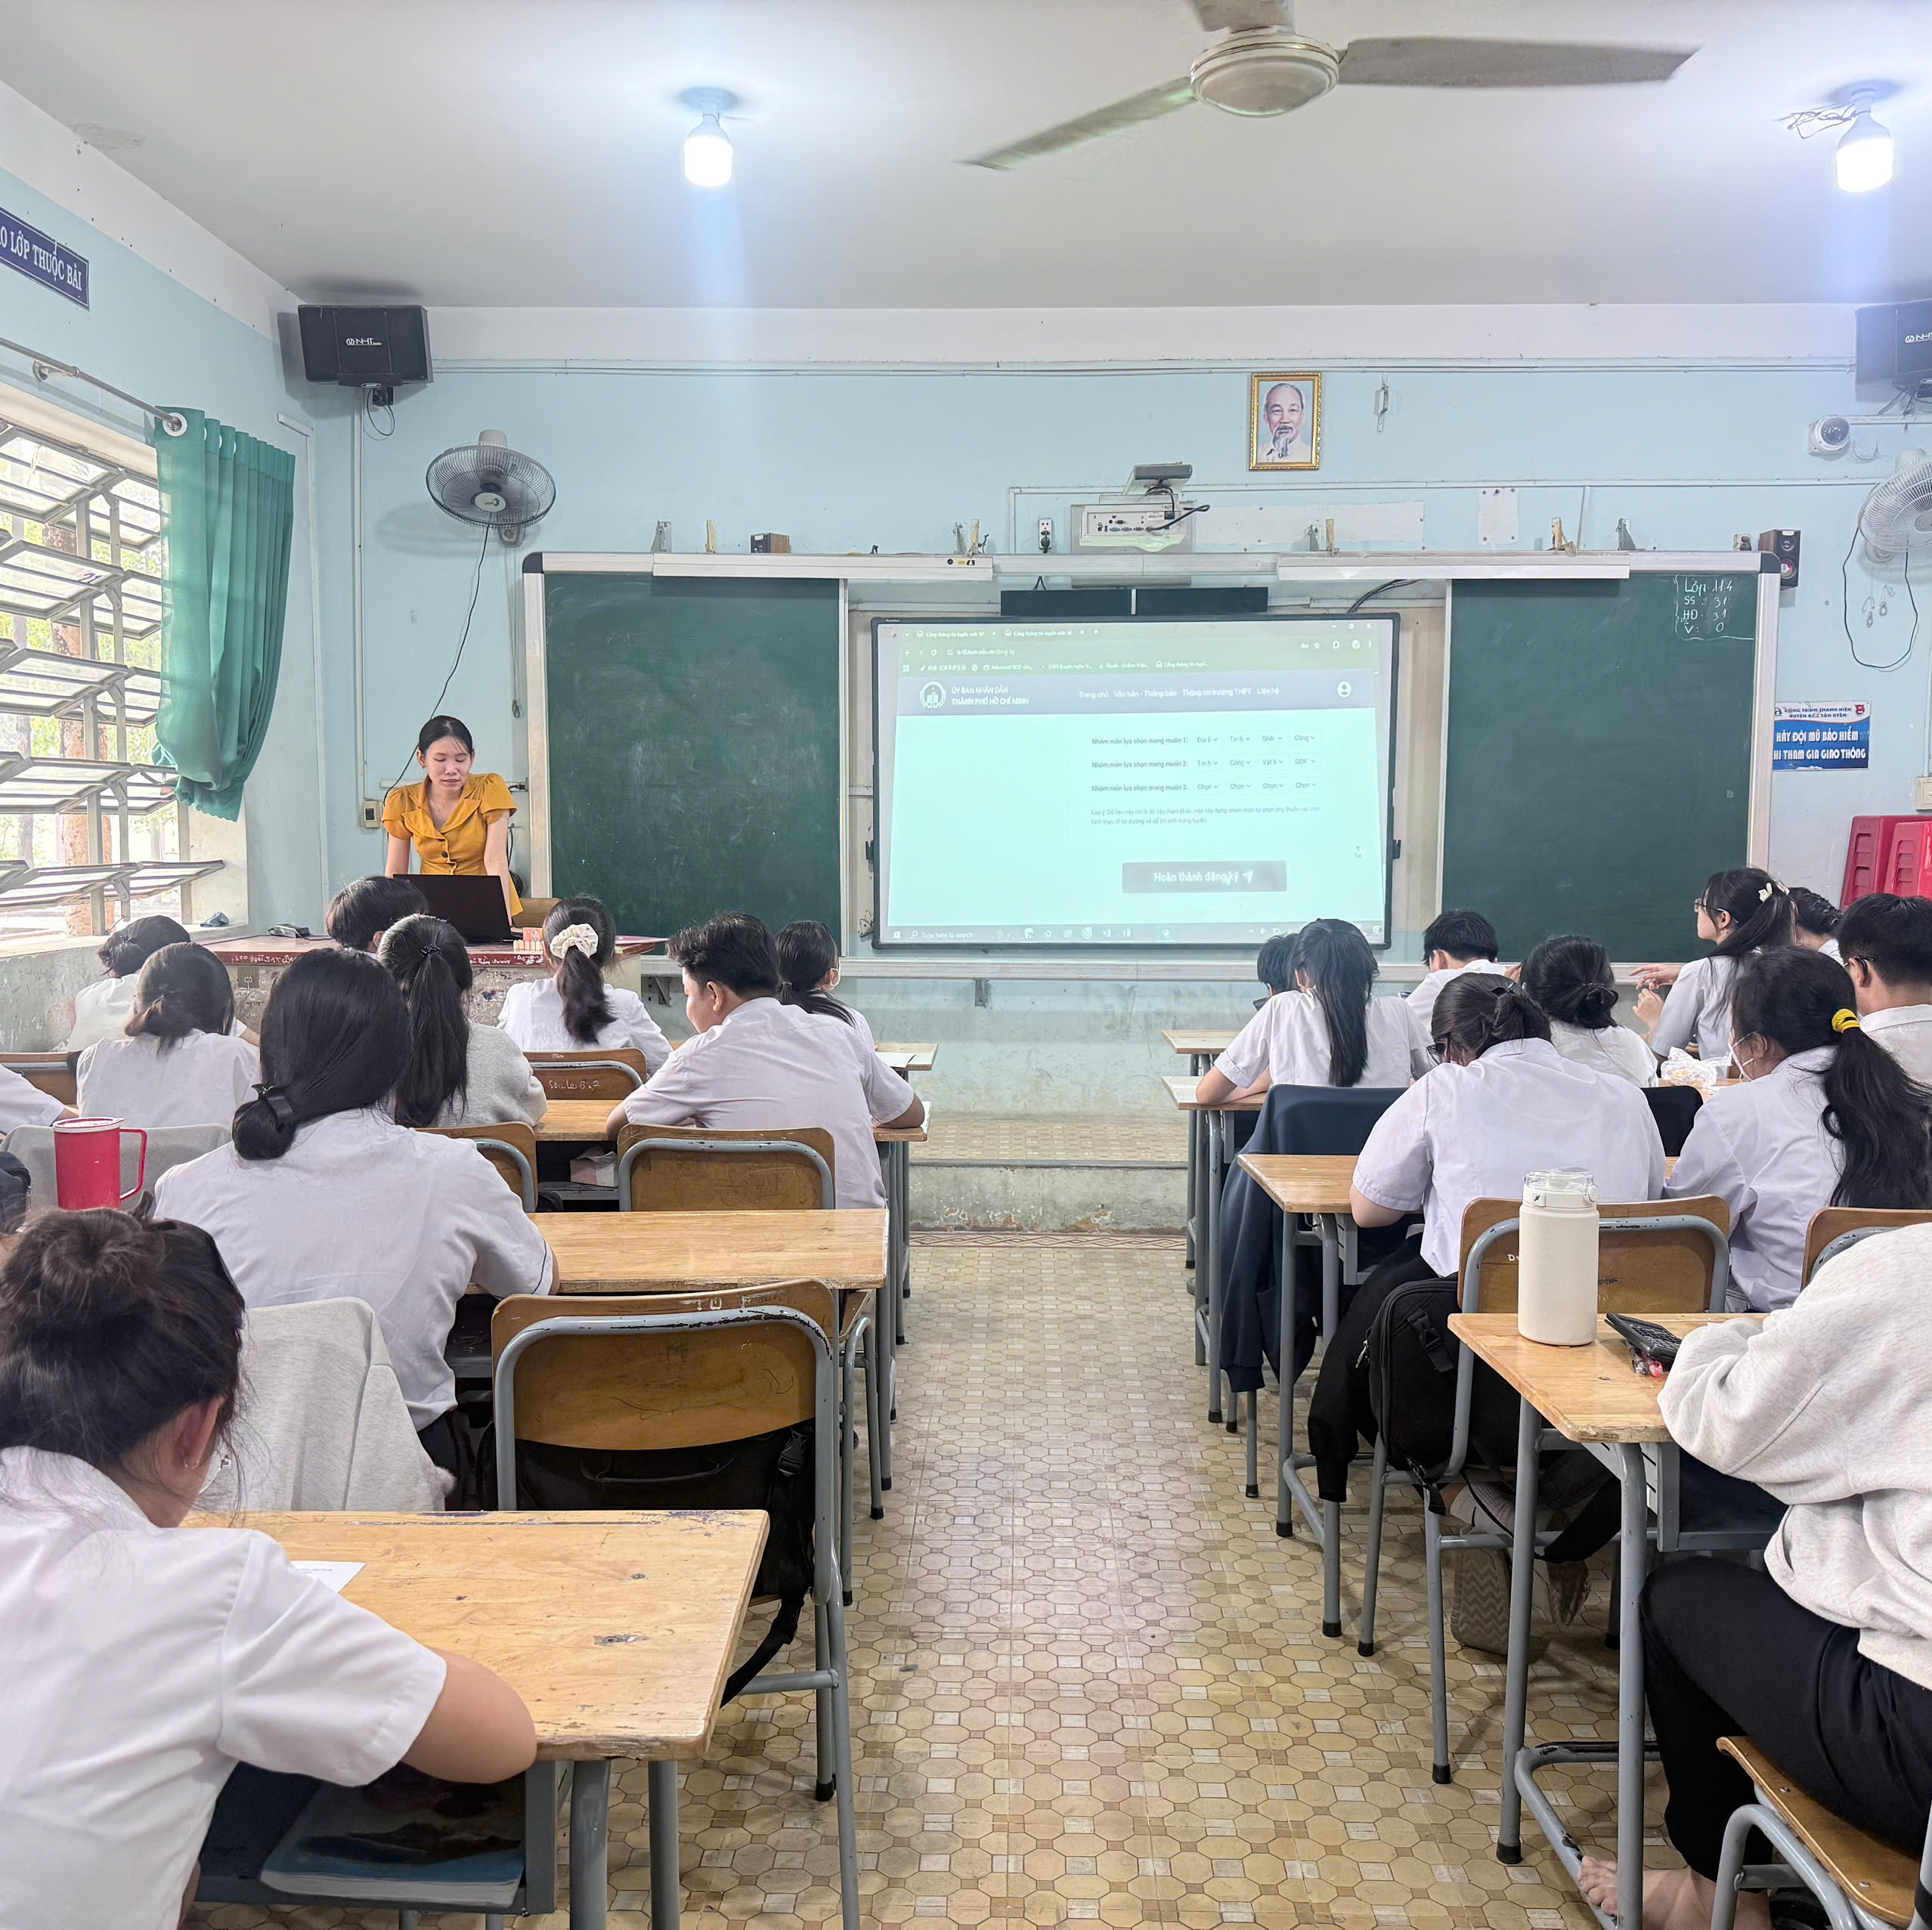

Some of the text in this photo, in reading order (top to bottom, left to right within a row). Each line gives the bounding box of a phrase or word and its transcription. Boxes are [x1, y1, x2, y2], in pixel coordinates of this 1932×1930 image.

[0, 226, 82, 291] O LỚP THUỘC BÀI
[1714, 596, 1727, 608] 31
[1713, 608, 1726, 621] 31
[961, 685, 974, 694] BAN
[975, 685, 993, 694] NHÂN
[995, 684, 1008, 693] DÂN
[1079, 691, 1095, 699] Trang
[952, 697, 973, 705] THÀNH
[1776, 725, 1859, 744] HÃY ĐỘI MŨ BẢO HIỂM
[1773, 746, 1866, 760] HI THAM GIA GIAO THÔNG
[1154, 871, 1176, 883] Hoàn
[1178, 871, 1203, 883] thành
[921, 930, 974, 939] Type here to search
